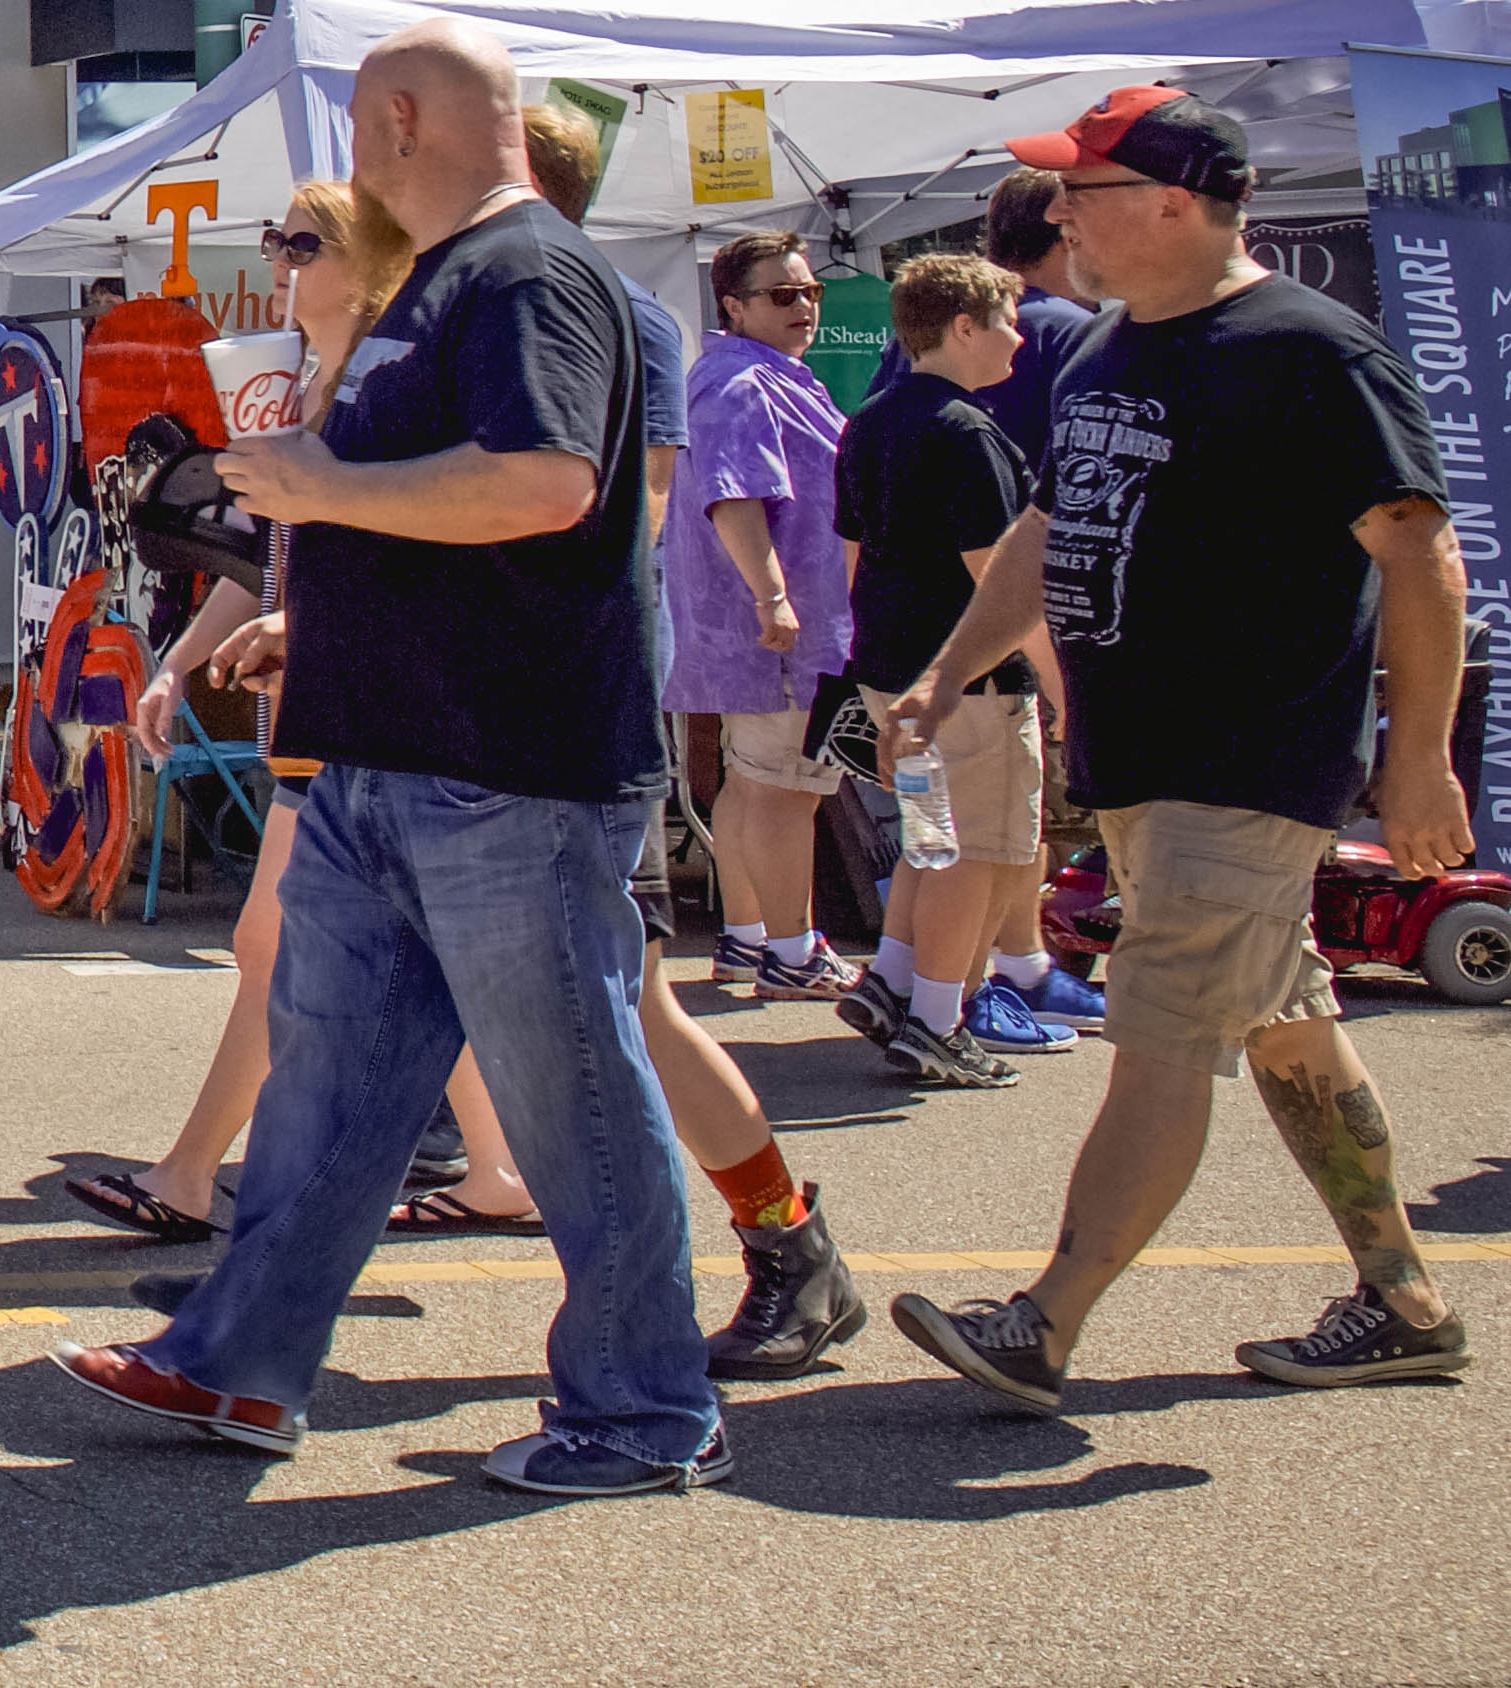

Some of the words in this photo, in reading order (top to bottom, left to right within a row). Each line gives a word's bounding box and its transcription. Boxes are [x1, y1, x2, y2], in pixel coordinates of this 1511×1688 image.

[731, 146, 760, 162] OFF
[1393, 234, 1472, 396] SQUARE
[1450, 501, 1502, 562] ON
